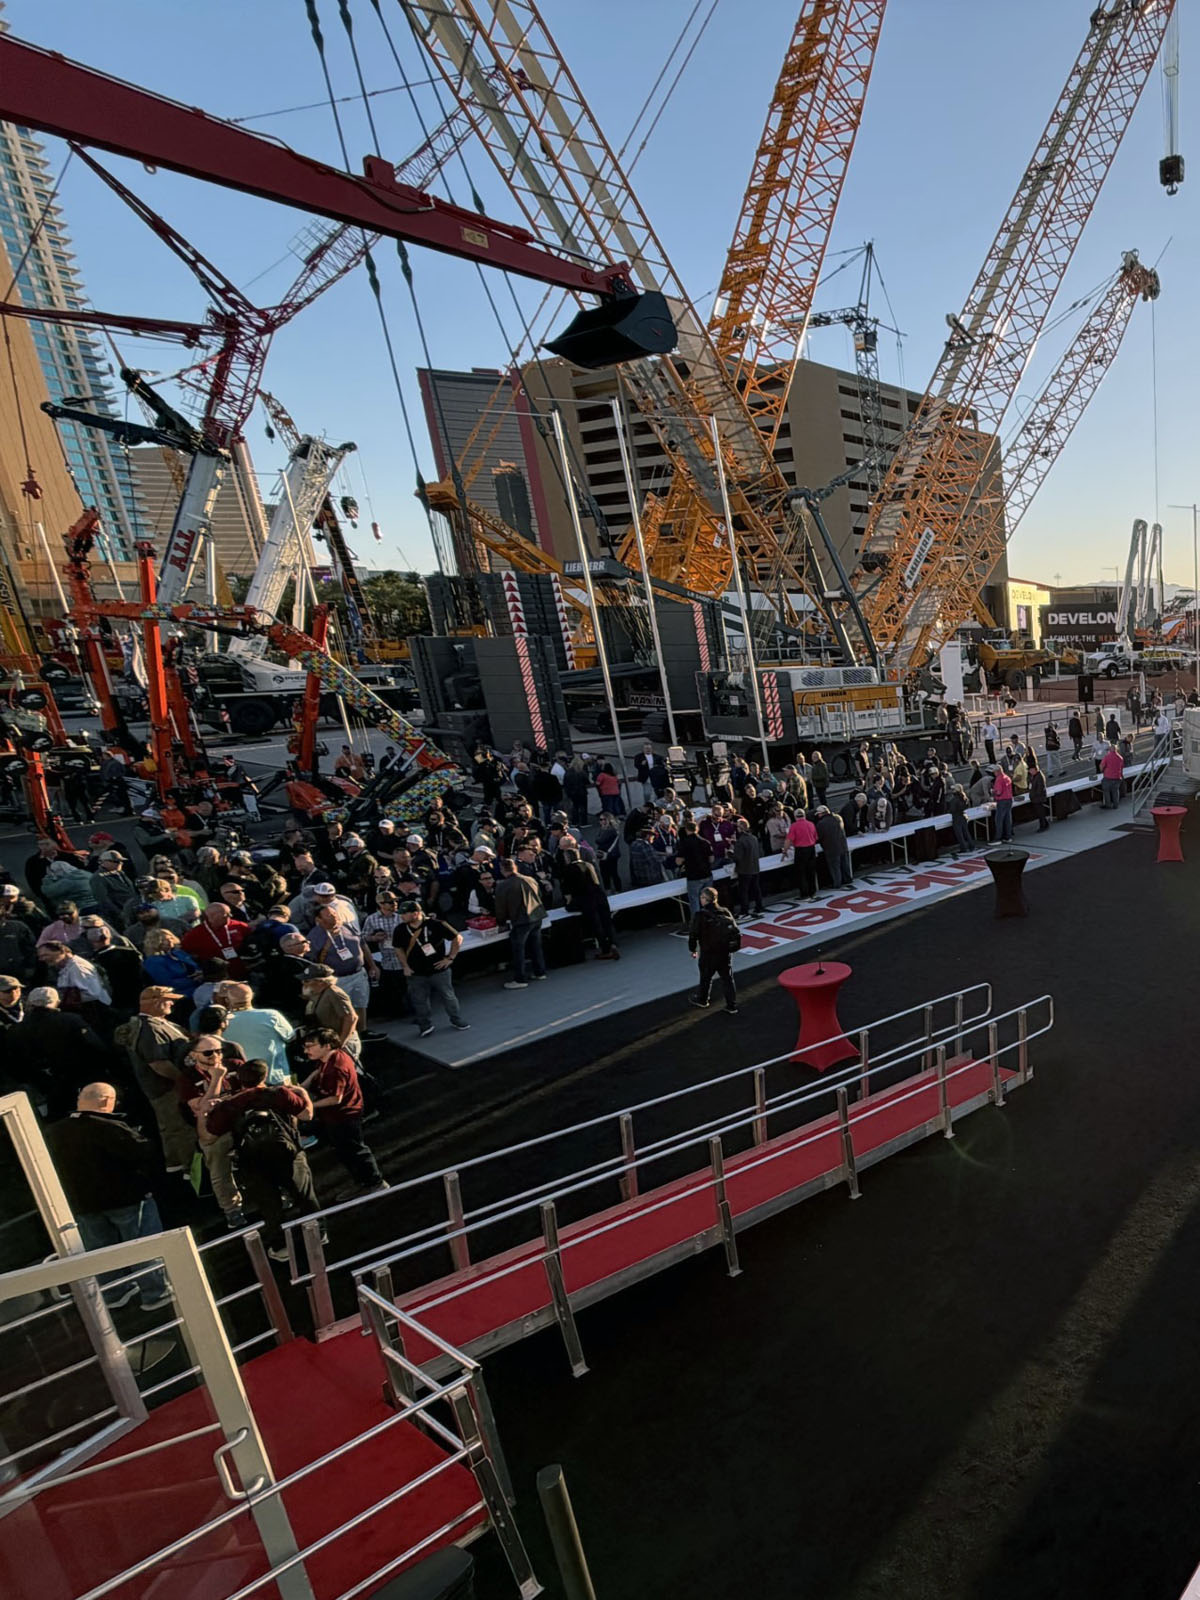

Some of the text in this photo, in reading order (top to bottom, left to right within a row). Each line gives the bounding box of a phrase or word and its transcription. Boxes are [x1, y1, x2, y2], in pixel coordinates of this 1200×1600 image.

[169, 529, 196, 573] ALL
[565, 561, 605, 572] LIEBERR
[1048, 612, 1117, 625] DEVELON
